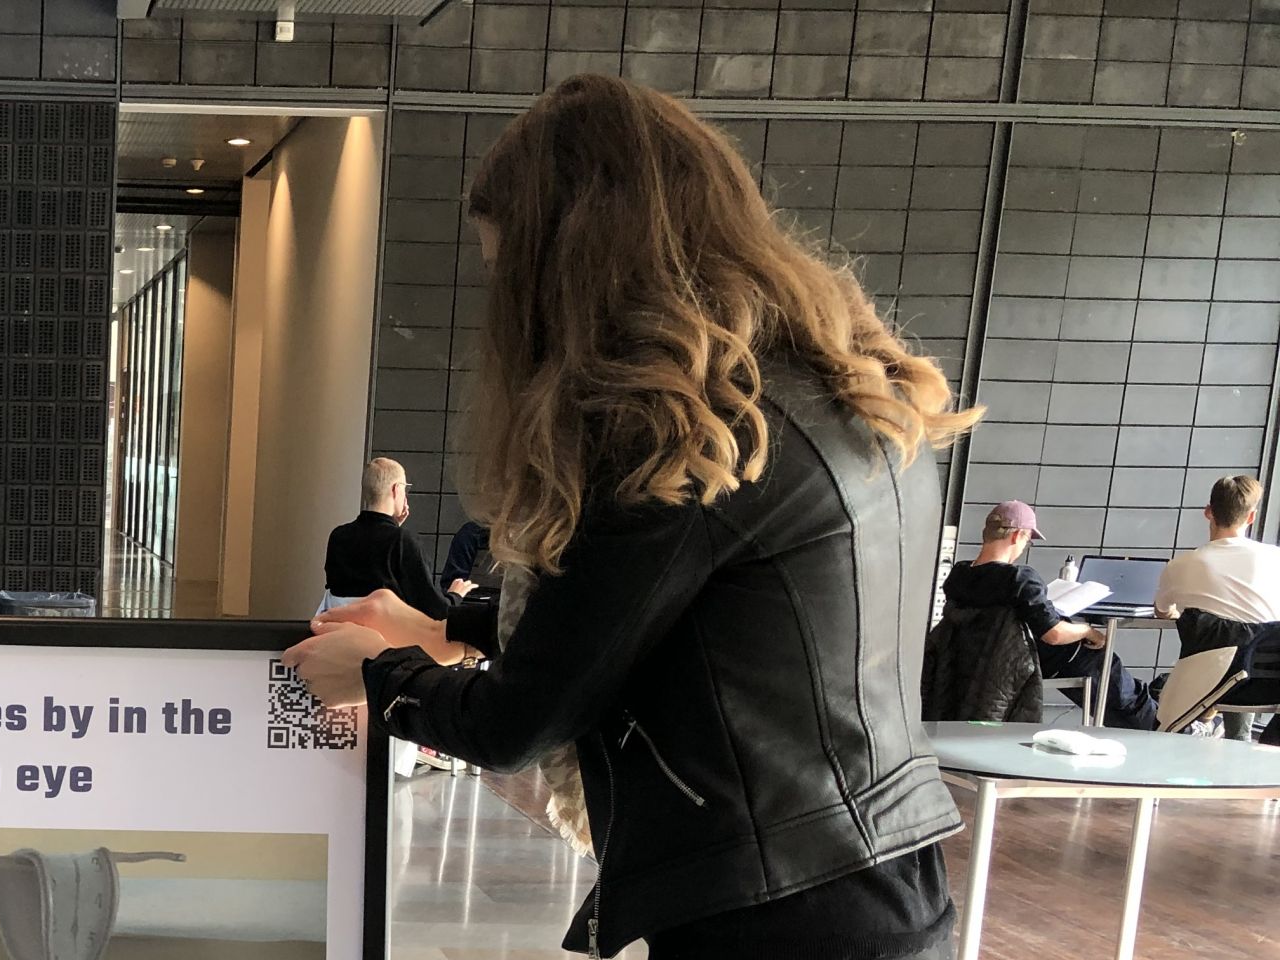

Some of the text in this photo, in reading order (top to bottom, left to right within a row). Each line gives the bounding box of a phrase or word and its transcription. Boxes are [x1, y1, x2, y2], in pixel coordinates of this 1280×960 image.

[43, 695, 94, 739] by
[108, 697, 147, 734] in
[161, 698, 232, 735] the
[16, 764, 93, 799] eye
